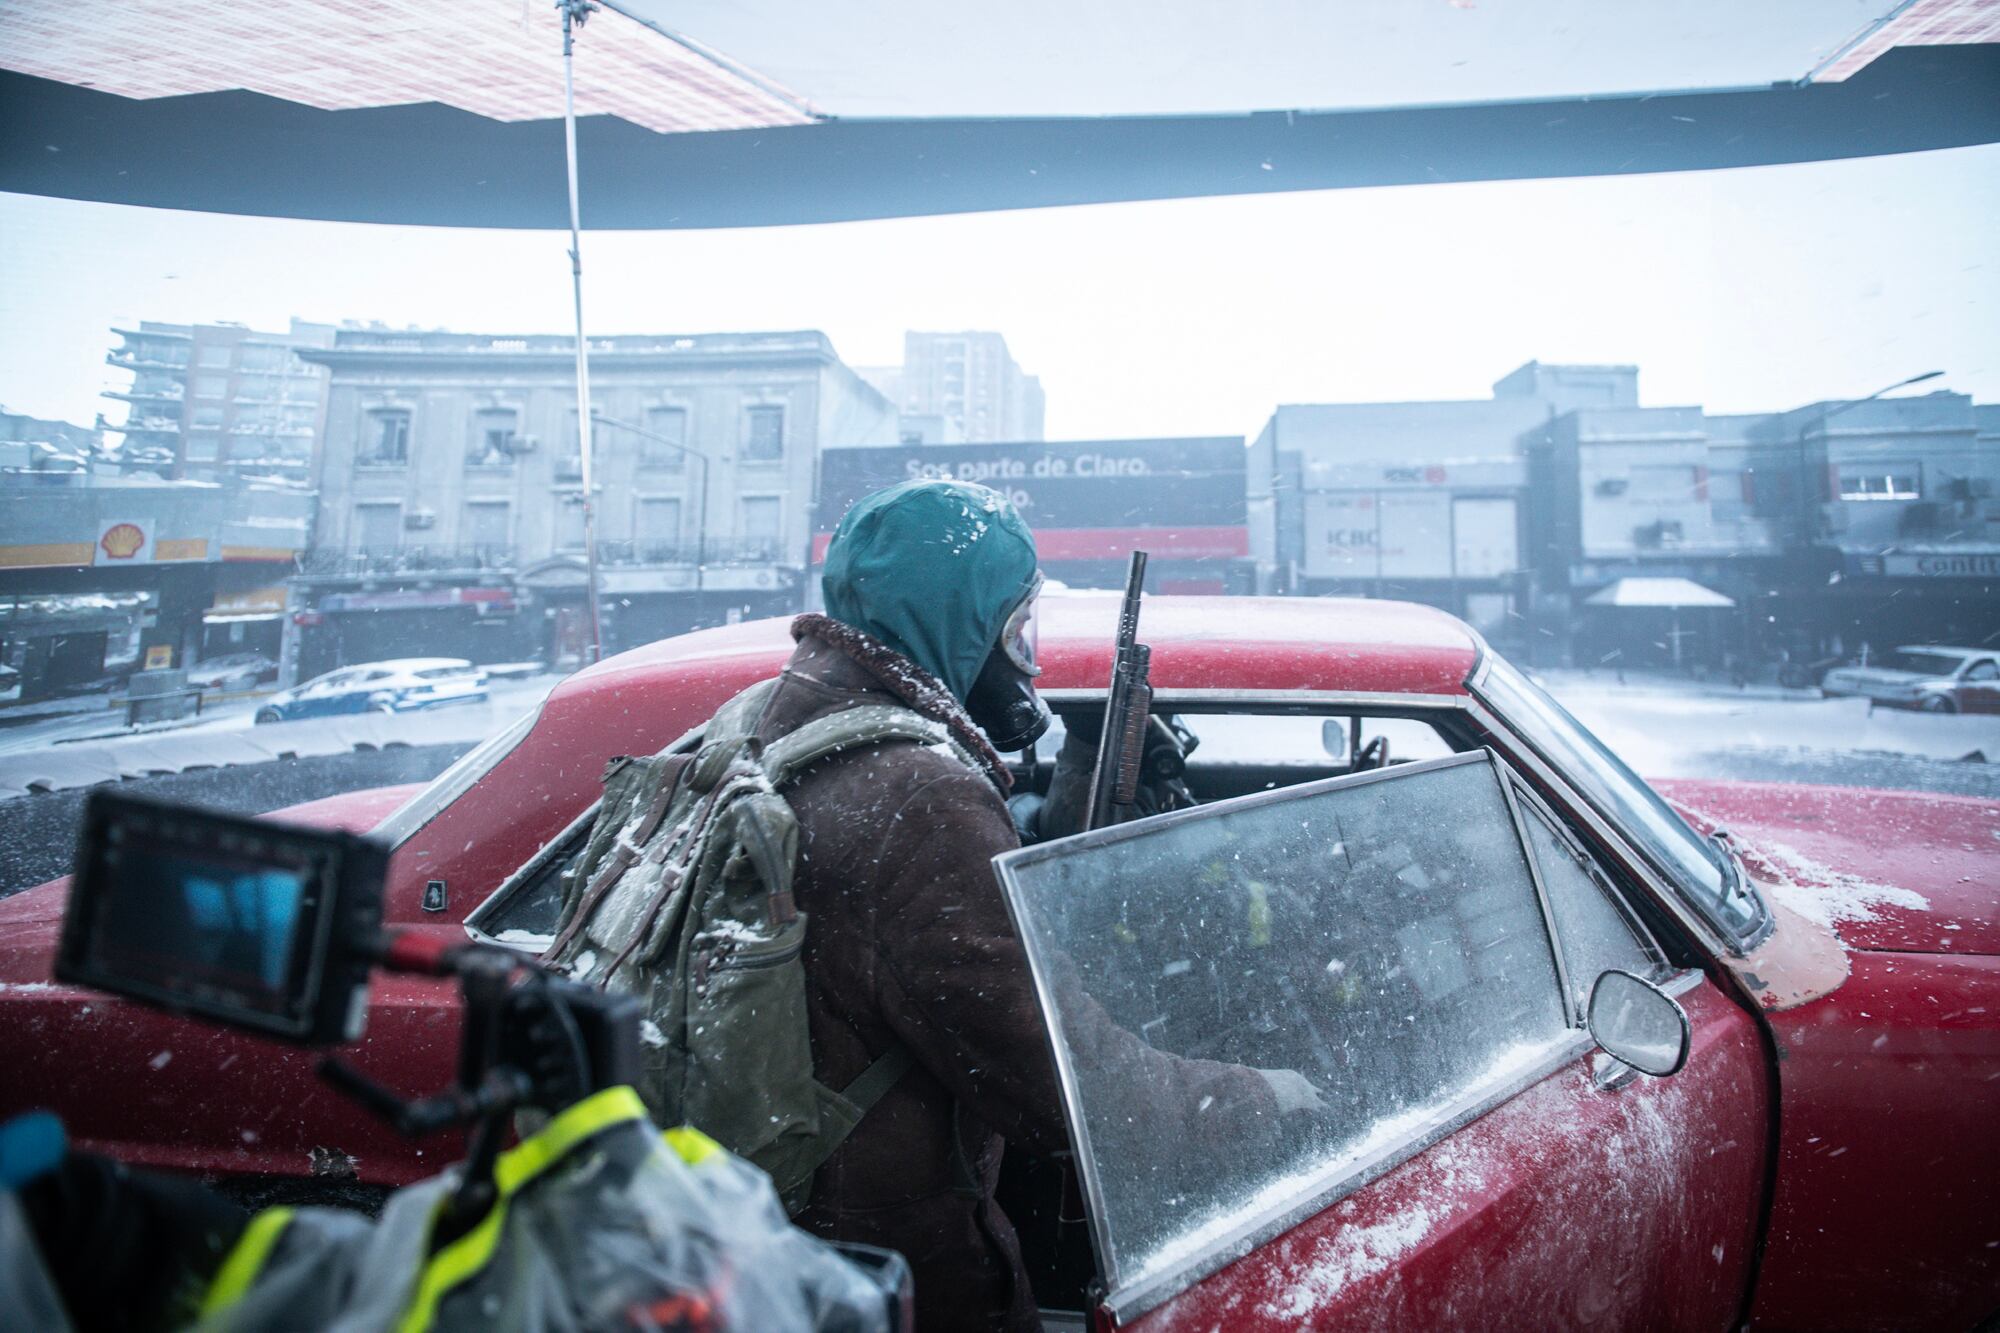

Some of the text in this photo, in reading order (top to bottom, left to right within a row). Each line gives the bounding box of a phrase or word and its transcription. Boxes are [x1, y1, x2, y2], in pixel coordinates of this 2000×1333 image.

[906, 453, 1152, 480] Sos parte de Claro.
[1327, 529, 1379, 547] ICBC
